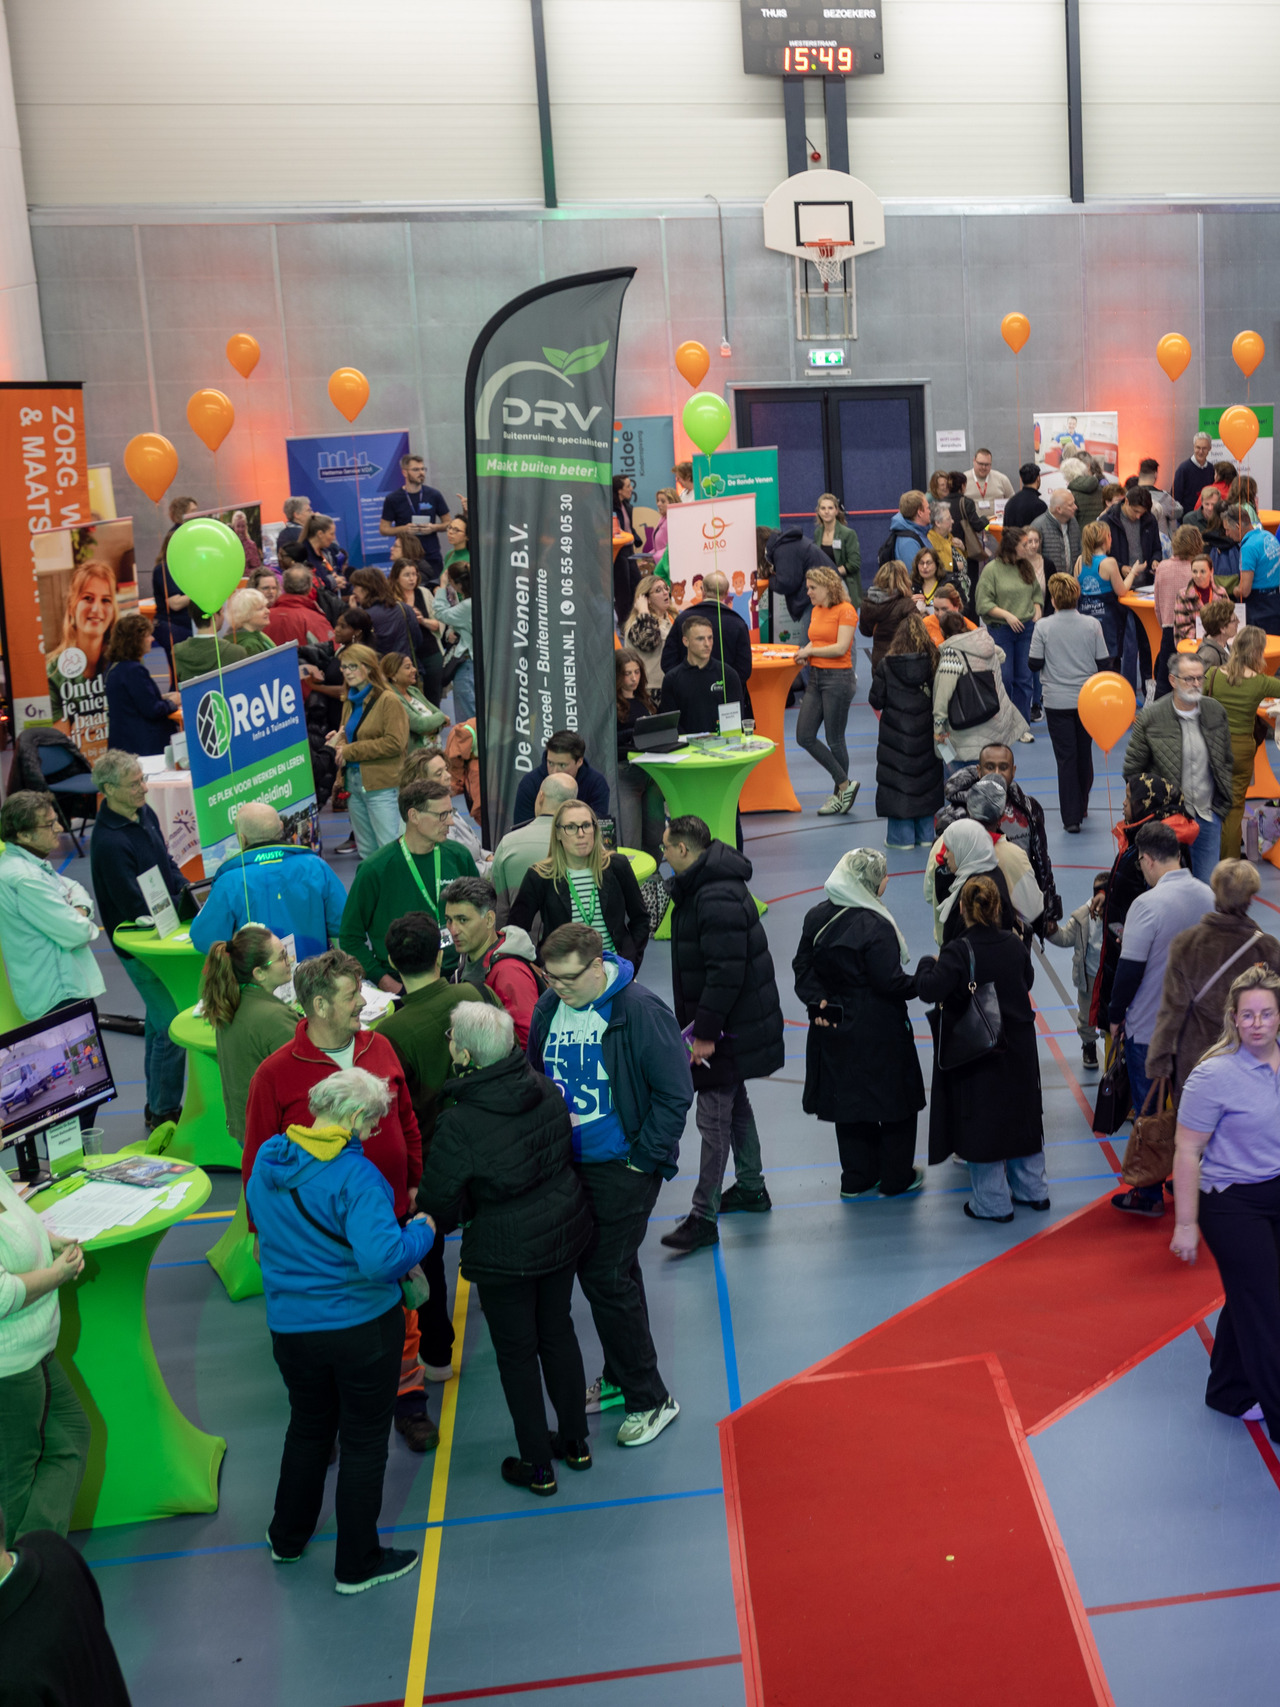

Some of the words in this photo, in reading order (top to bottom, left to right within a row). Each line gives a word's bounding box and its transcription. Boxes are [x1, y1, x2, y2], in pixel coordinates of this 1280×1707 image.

[761, 8, 787, 18] THUIS
[824, 9, 876, 18] BEZOEKERS
[784, 47, 852, 72] 15:49
[20, 406, 43, 427] &
[502, 397, 602, 432] DRV
[52, 406, 78, 495] ZORG,
[503, 431, 555, 443] Buitenruimte
[558, 436, 608, 449] specialisten
[487, 458, 518, 472] Maakt
[520, 460, 557, 475] buiten
[560, 464, 598, 478] beter!
[560, 494, 572, 511] 30
[560, 514, 572, 532] 05
[509, 523, 530, 569] B.V.
[560, 536, 572, 554] 49
[704, 539, 726, 551] AURO
[561, 558, 573, 574] 55
[561, 578, 574, 596] 06
[512, 575, 530, 648] Venen
[536, 568, 550, 673] Buitenruimte
[515, 656, 531, 736] Ronde
[229, 678, 296, 737] ReVe
[252, 730, 266, 741] Infra
[266, 728, 270, 736] &
[514, 741, 534, 772] De
[208, 795, 218, 808] DE
[216, 788, 234, 803] PLEK
[234, 779, 252, 795] VOOR
[252, 768, 278, 786] WERKEN
[277, 764, 287, 773] EN
[286, 754, 306, 770] LEREN
